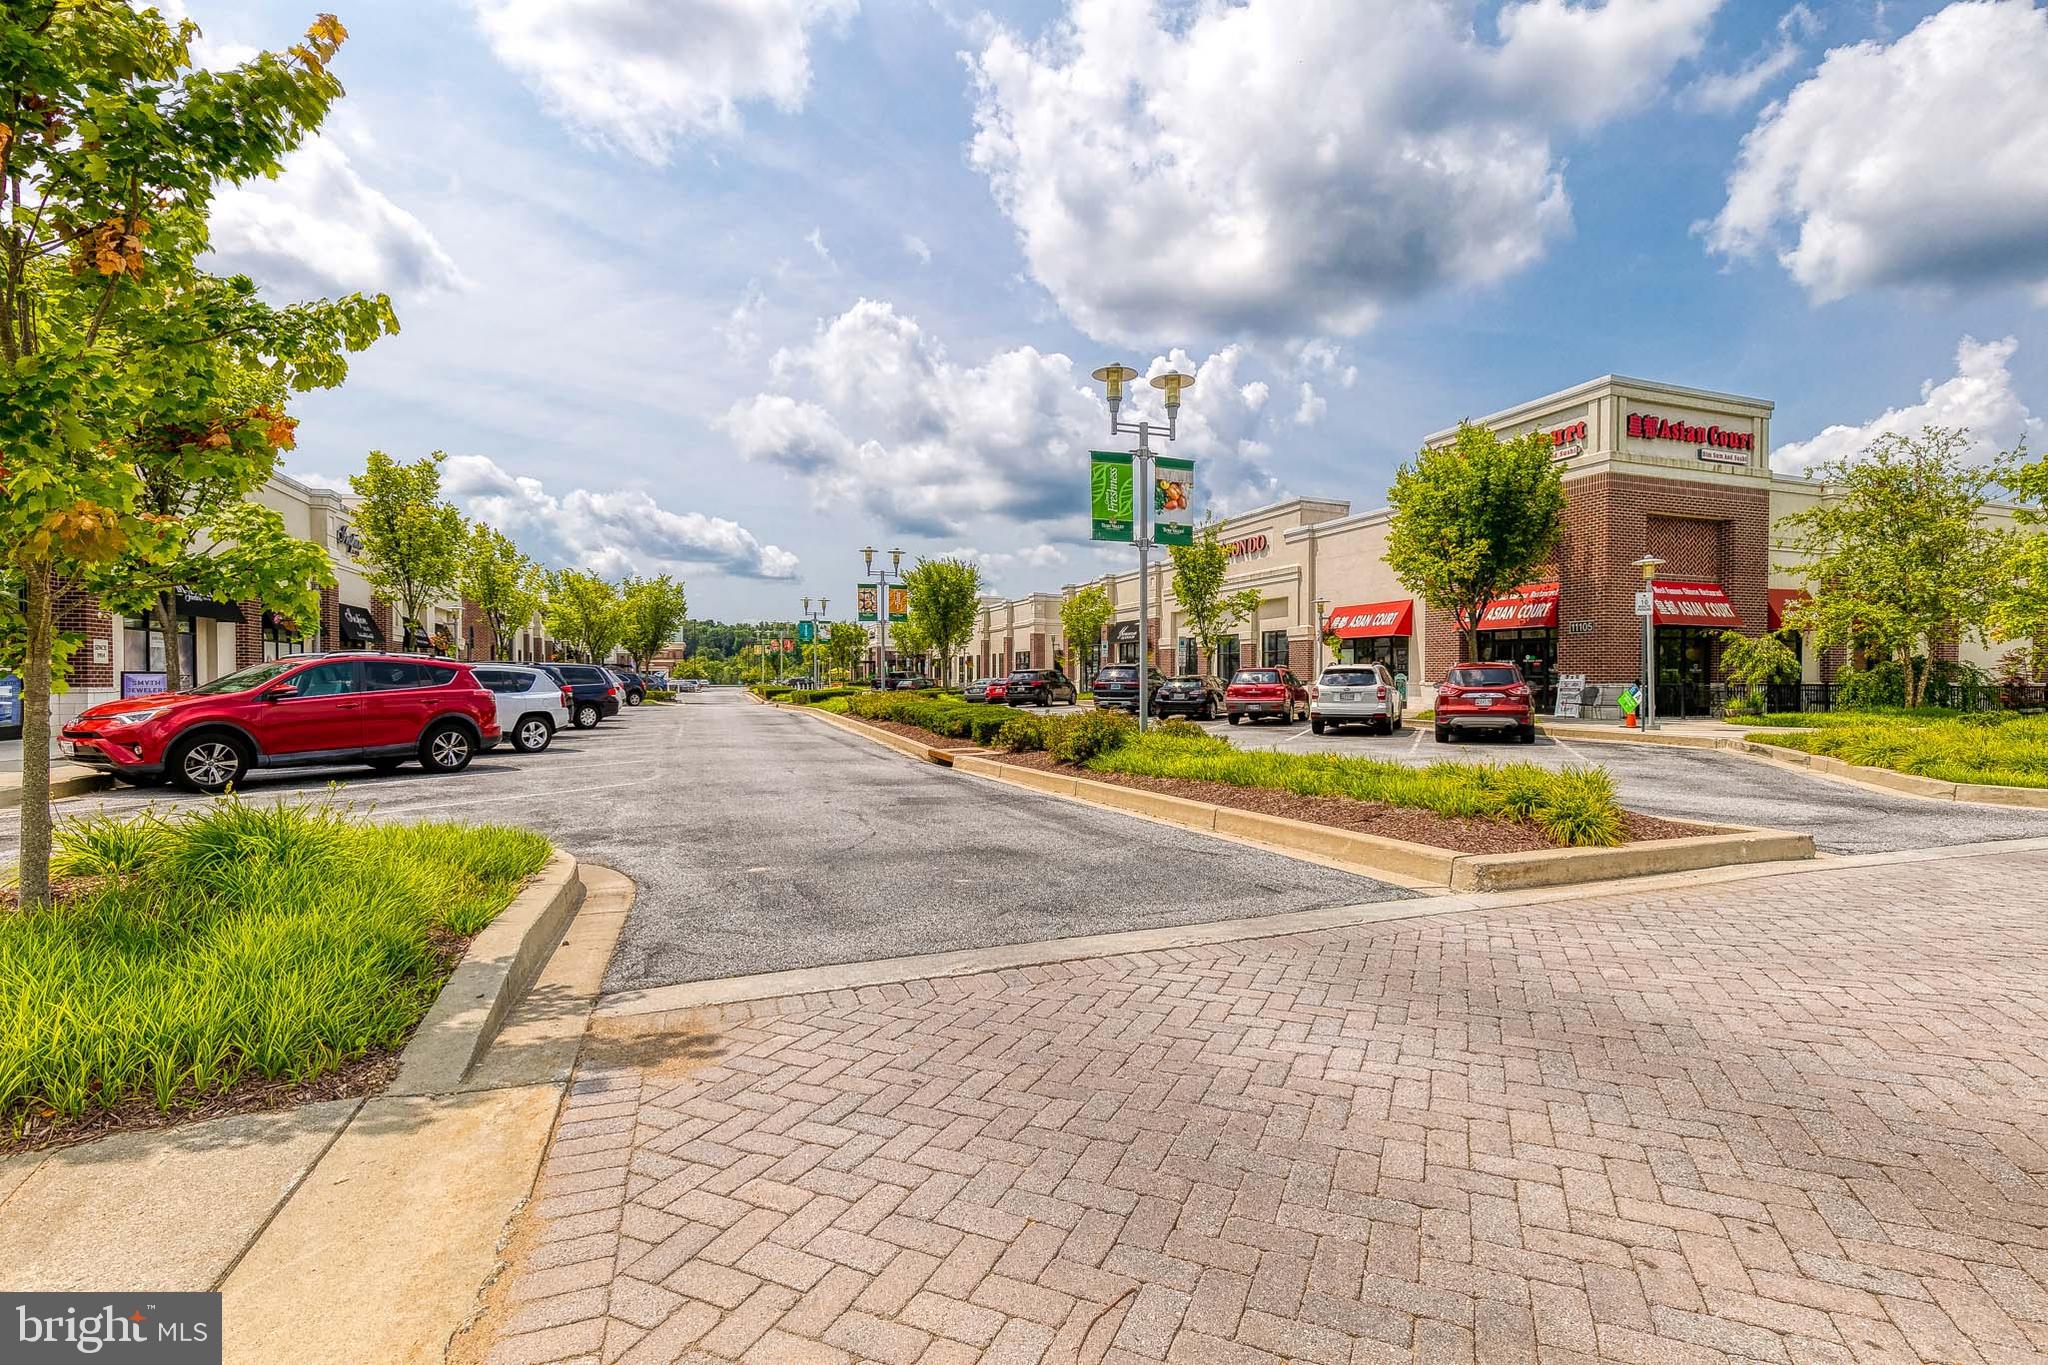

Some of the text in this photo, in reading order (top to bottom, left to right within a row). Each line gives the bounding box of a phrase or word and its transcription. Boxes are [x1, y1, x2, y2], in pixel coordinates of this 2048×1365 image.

[1551, 421, 1587, 446] urt
[1659, 418, 1706, 444] Asian
[1707, 425, 1755, 450] Court
[1108, 467, 1118, 513] Freshness
[1486, 604, 1517, 620] ASIAN
[1518, 602, 1551, 619] COURT
[1678, 601, 1708, 617] ASIAN
[1705, 602, 1736, 618] COURT
[1348, 614, 1373, 628] ASIAN
[1373, 611, 1399, 626] COURT
[1571, 622, 1593, 632] 11105
